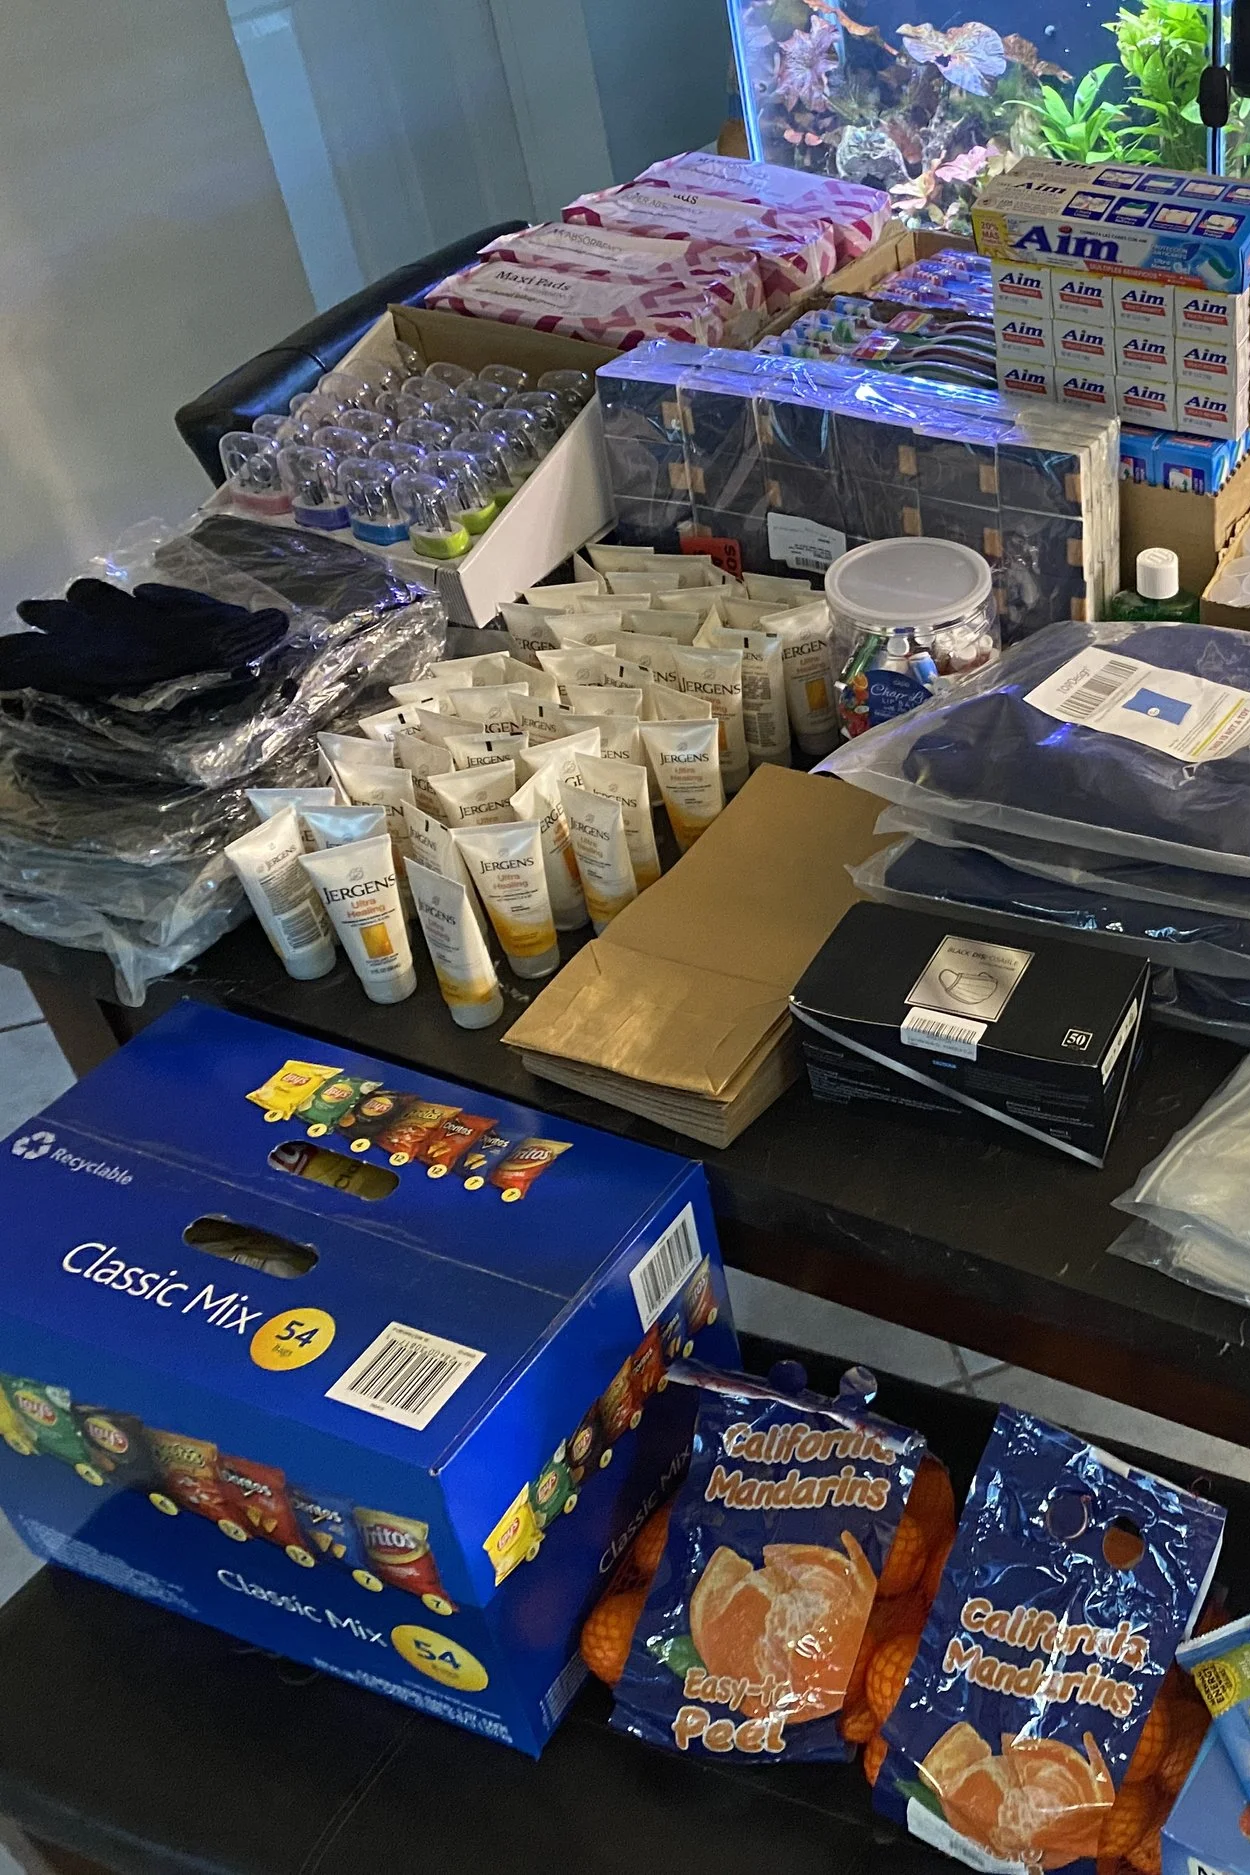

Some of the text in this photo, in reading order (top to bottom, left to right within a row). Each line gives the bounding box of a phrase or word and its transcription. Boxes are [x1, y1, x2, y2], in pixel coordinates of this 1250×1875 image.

[1015, 181, 1067, 195] Aim
[1009, 225, 1121, 263] Aim
[496, 270, 573, 292] Maxi Pads
[1000, 272, 1042, 289] Aim
[1060, 281, 1102, 298] Aim
[1121, 289, 1165, 306] Aim
[1184, 299, 1228, 316] Aim
[1002, 321, 1043, 337] Aim
[1062, 329, 1104, 346] Aim
[1123, 338, 1166, 355] Aim
[1184, 347, 1228, 365] Aim
[1004, 369, 1046, 385] Aim
[1063, 377, 1105, 394] Aim
[1124, 385, 1166, 402] Aim
[1185, 395, 1228, 413] Aim
[679, 677, 741, 696] JERGENS
[521, 715, 557, 733] JERGENS
[660, 752, 710, 766] JERGENS
[459, 799, 511, 820] JERGENS
[570, 817, 611, 841] JERGENS
[409, 825, 438, 852] JERGENS
[265, 844, 297, 870] JERGENS
[480, 857, 534, 875] JERGENS
[493, 880, 529, 889] Healing
[497, 873, 521, 881] Ultra
[322, 873, 396, 905] JERGENS
[346, 903, 386, 919] Healing
[351, 897, 377, 909] Ultra
[418, 897, 457, 926] JERGENS
[1066, 1032, 1087, 1046] 50
[442, 1121, 474, 1138] Doritos
[50, 1147, 134, 1186] Recyclable
[393, 1153, 406, 1164] 12
[430, 1166, 444, 1176] 12
[61, 1241, 263, 1335] Classic Mix
[275, 1319, 321, 1349] 54
[705, 1465, 892, 1511] Mandarins
[599, 1444, 692, 1575] Classic Mix
[217, 1569, 389, 1648] Classic Mix
[961, 1597, 1151, 1670] California
[414, 1638, 462, 1670] 54
[942, 1638, 1138, 1718] Mandarins
[672, 1706, 787, 1753] Peel
